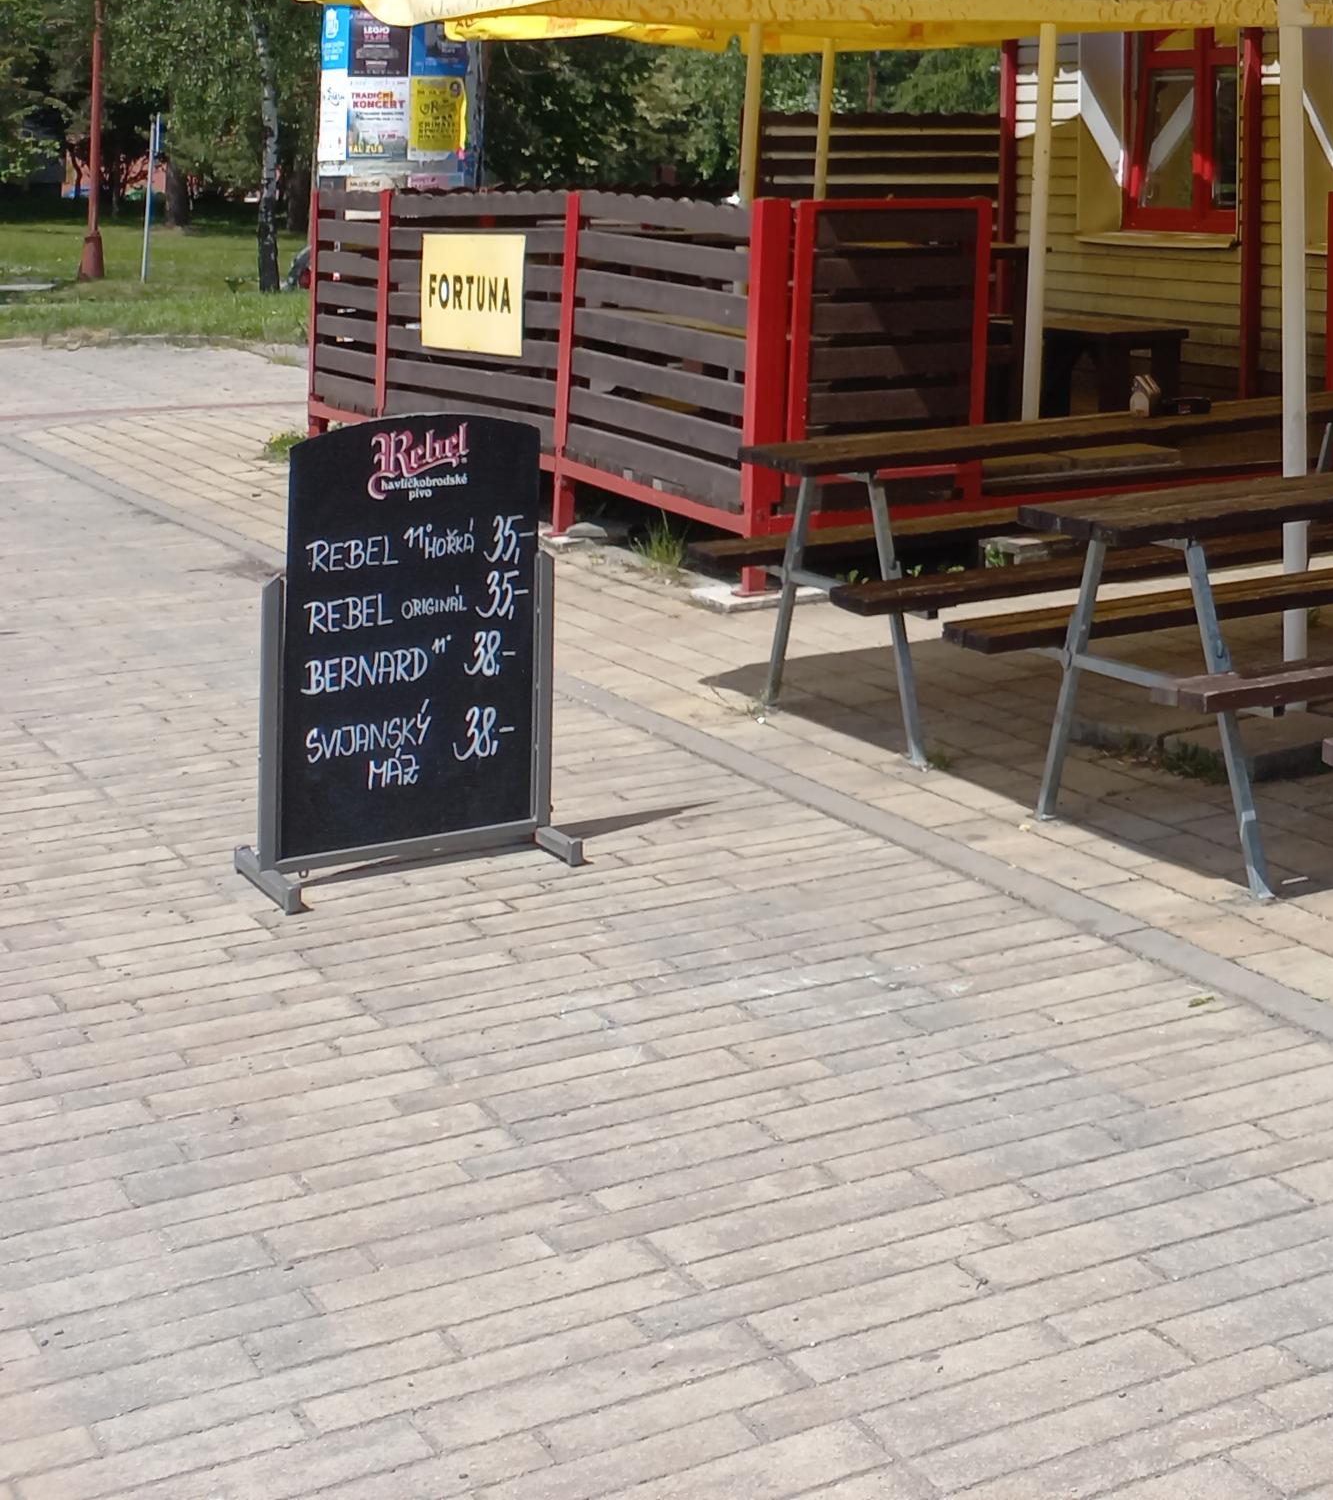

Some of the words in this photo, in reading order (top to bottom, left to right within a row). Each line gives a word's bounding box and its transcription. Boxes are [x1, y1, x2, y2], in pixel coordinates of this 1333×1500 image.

[352, 99, 406, 110] KONCERT
[428, 273, 512, 314] FORTUNA
[370, 421, 470, 478] Rebel
[408, 488, 433, 502] pivo
[305, 534, 399, 573] REBEL
[424, 517, 476, 560] HOŘKÁ
[303, 592, 394, 634] REBEL
[401, 584, 468, 620] ORIGINÁL
[300, 646, 429, 696] BERNARD
[305, 698, 432, 764] SVIJANSKÝ
